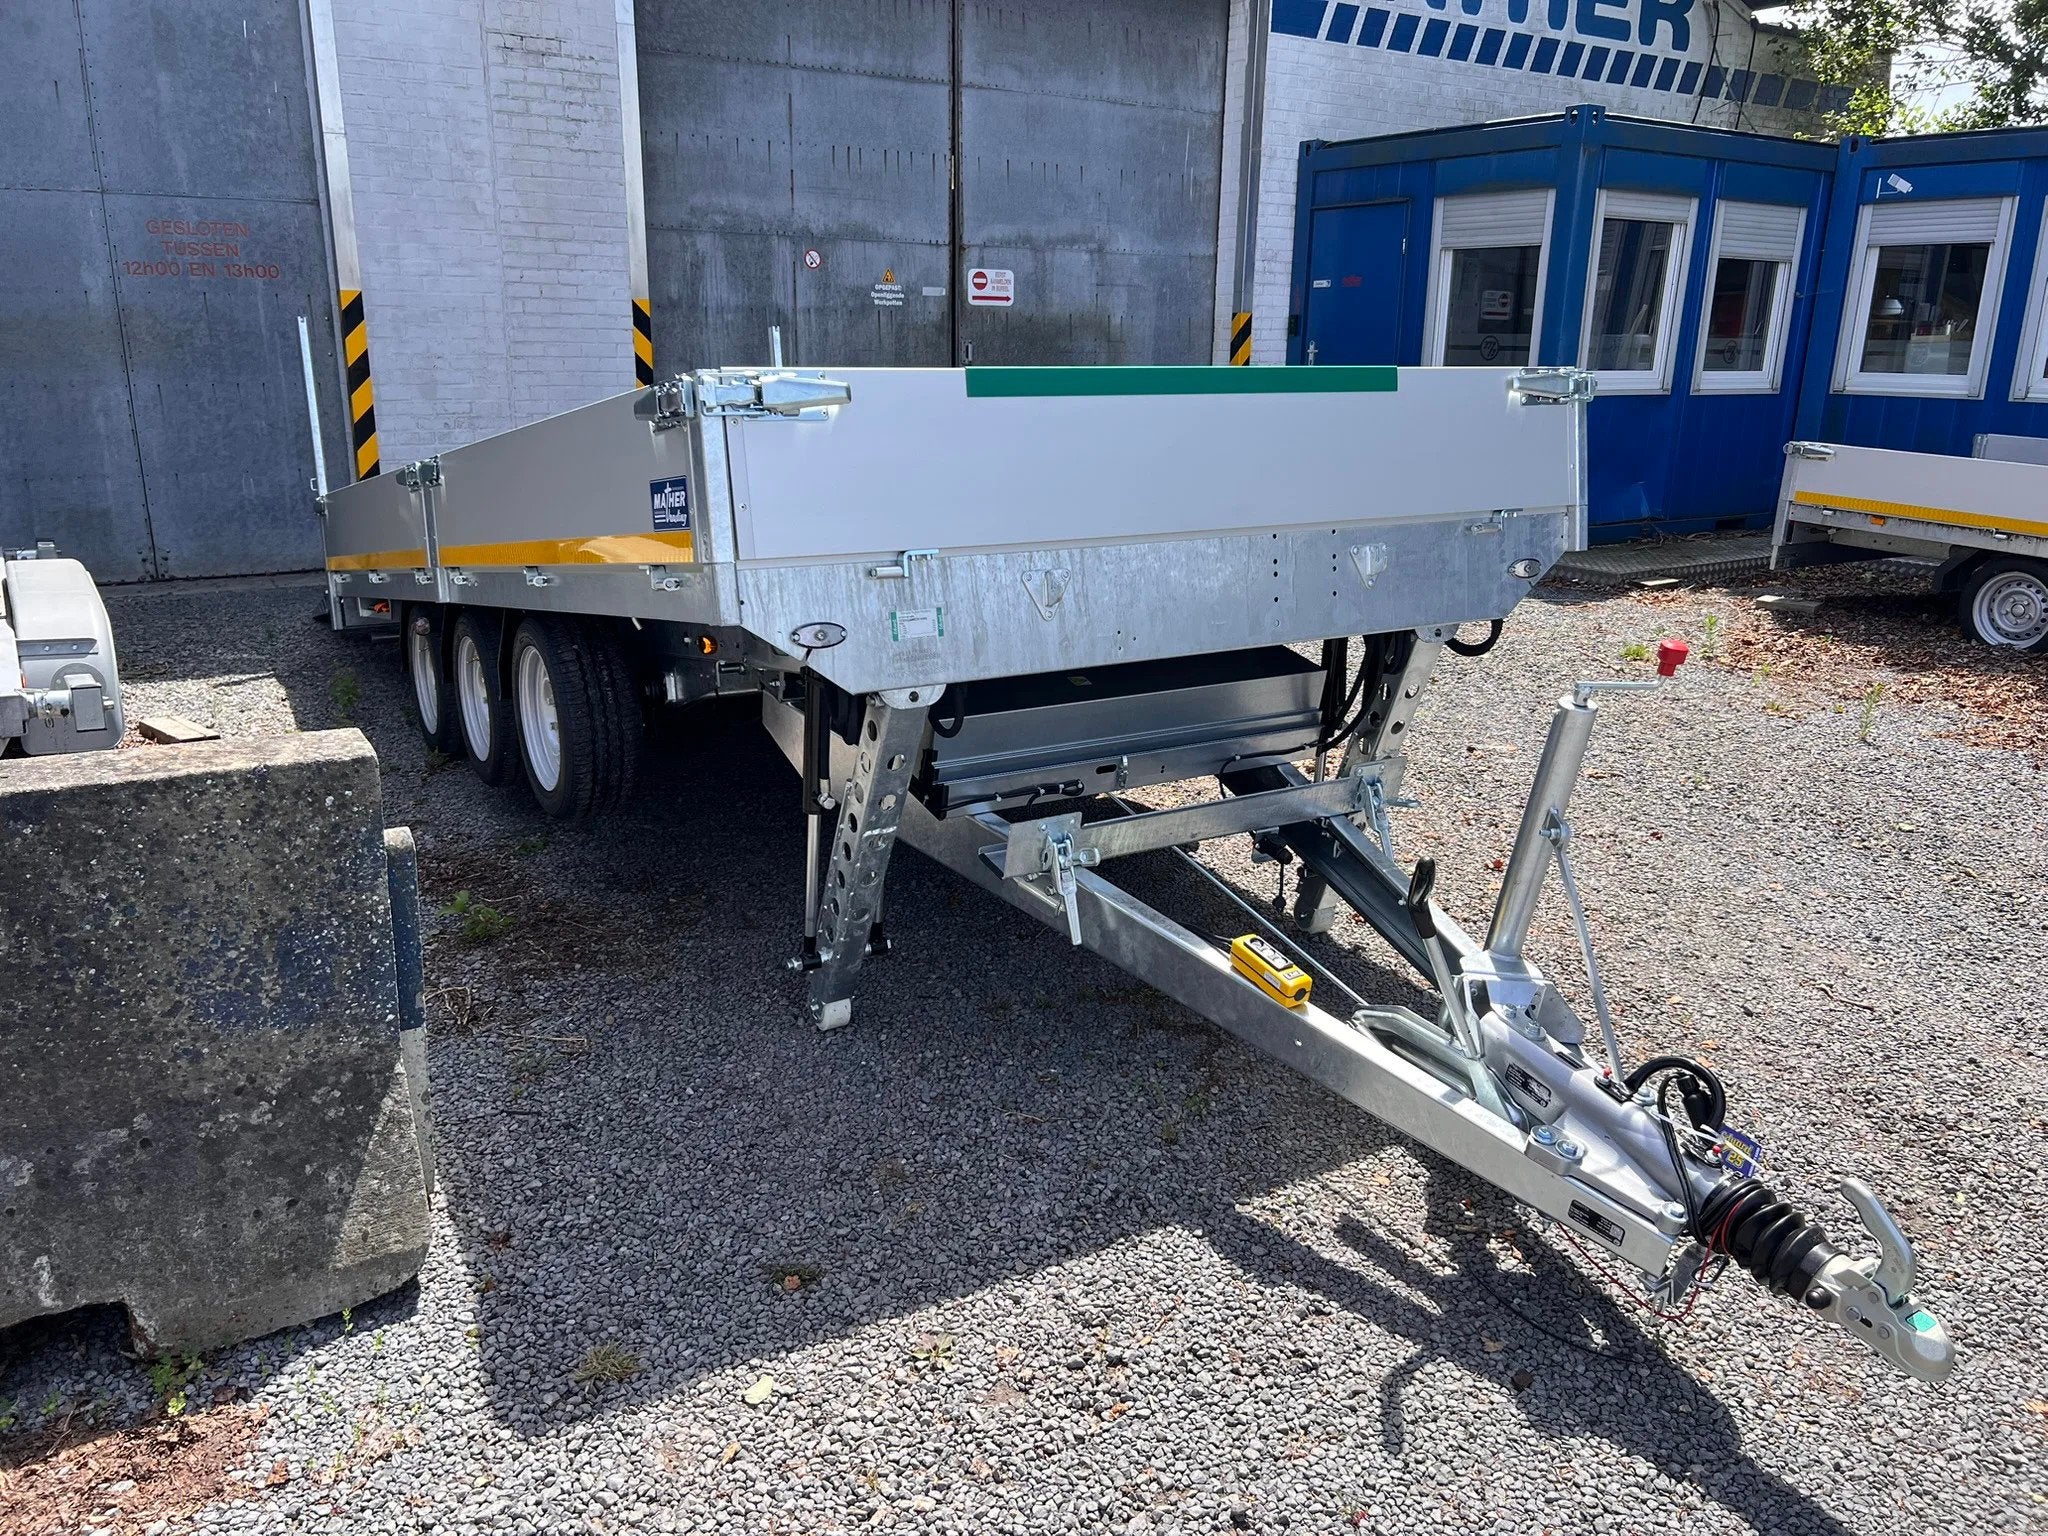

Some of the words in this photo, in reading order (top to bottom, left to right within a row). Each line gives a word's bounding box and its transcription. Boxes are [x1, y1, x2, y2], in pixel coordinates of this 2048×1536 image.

[145, 219, 249, 238] GESLOTEN
[161, 240, 240, 257] TUSSEN
[123, 261, 181, 277] 12h00
[189, 262, 217, 277] EN
[224, 263, 280, 279] 13h00
[653, 485, 686, 509] MATHER
